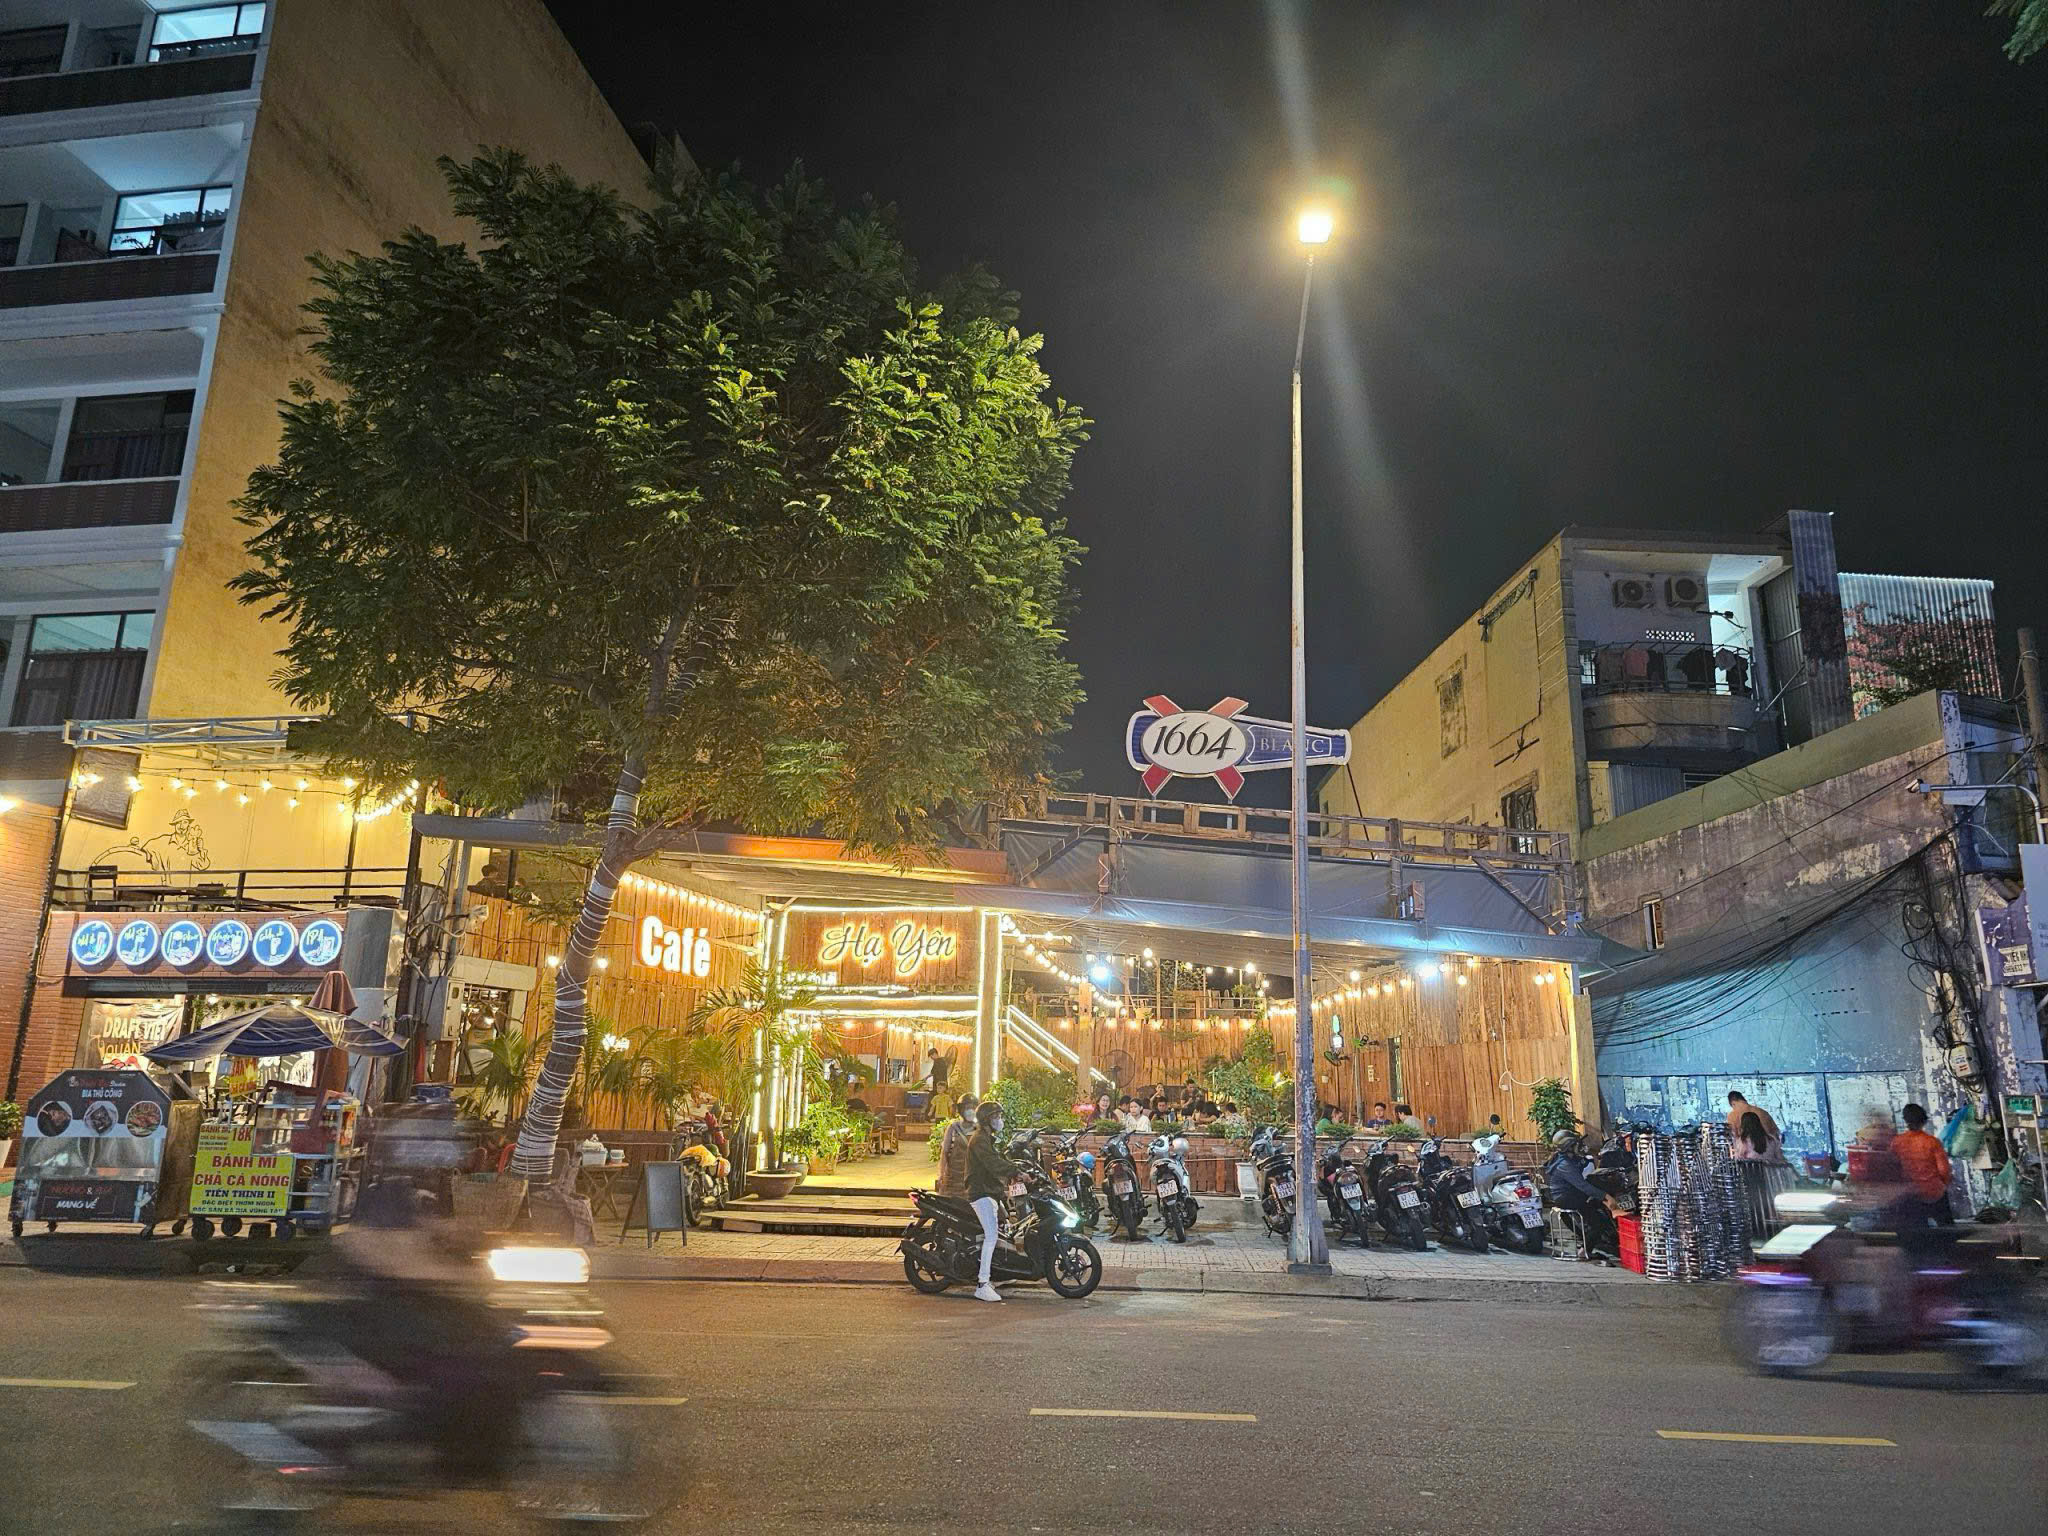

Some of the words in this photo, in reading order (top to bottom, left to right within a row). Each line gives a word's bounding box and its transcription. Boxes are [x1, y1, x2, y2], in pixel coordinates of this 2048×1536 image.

[1152, 720, 1236, 760] 1664
[1260, 738, 1324, 753] BLAC
[641, 915, 711, 977] Café
[822, 926, 881, 963] Hạ
[892, 923, 954, 974] Yên
[232, 1128, 253, 1141] 18K
[212, 1153, 253, 1168] BÁNH
[194, 1171, 222, 1185] CHẢ
[227, 1173, 245, 1186] CÁ
[250, 1173, 289, 1187] NÓNG
[267, 1191, 276, 1199] II
